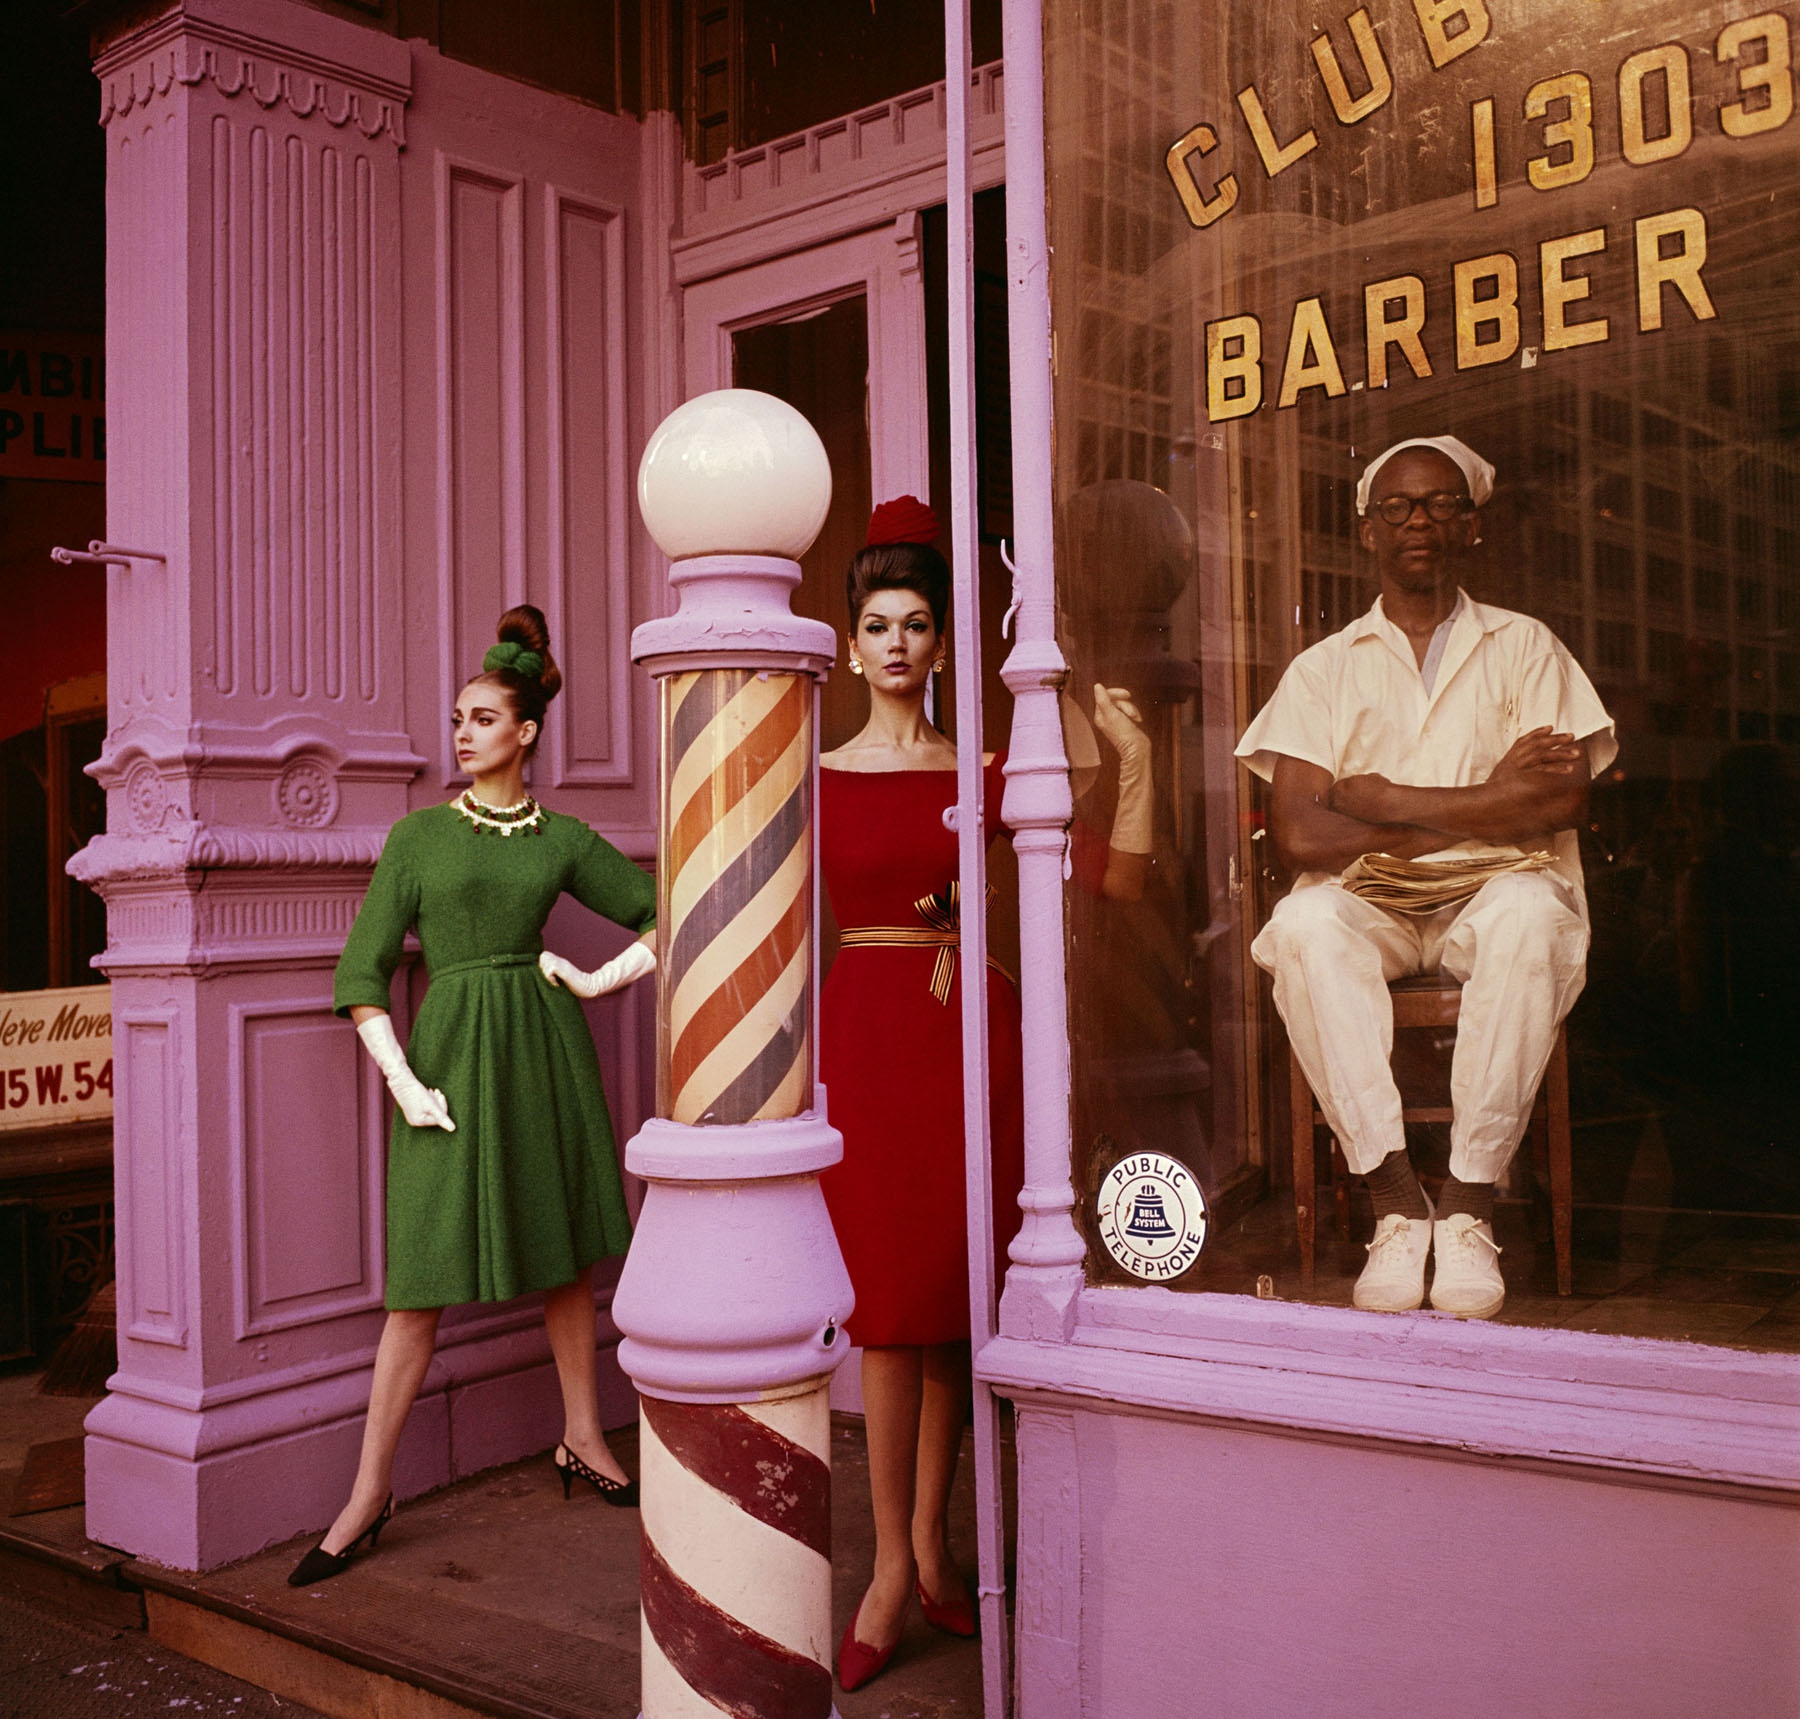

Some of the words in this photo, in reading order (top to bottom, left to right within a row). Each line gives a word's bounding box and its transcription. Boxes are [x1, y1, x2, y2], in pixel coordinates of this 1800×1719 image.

[1470, 11, 1794, 209] 1303
[1205, 206, 1717, 424] BARBER
[36, 1064, 68, 1105] W.
[74, 1058, 113, 1101] 54
[1112, 1158, 1187, 1188] PUBLIC
[1134, 1218, 1165, 1228] SYSTEM
[1139, 1208, 1160, 1218] BELL
[1105, 1226, 1200, 1277] TELEPHONE
